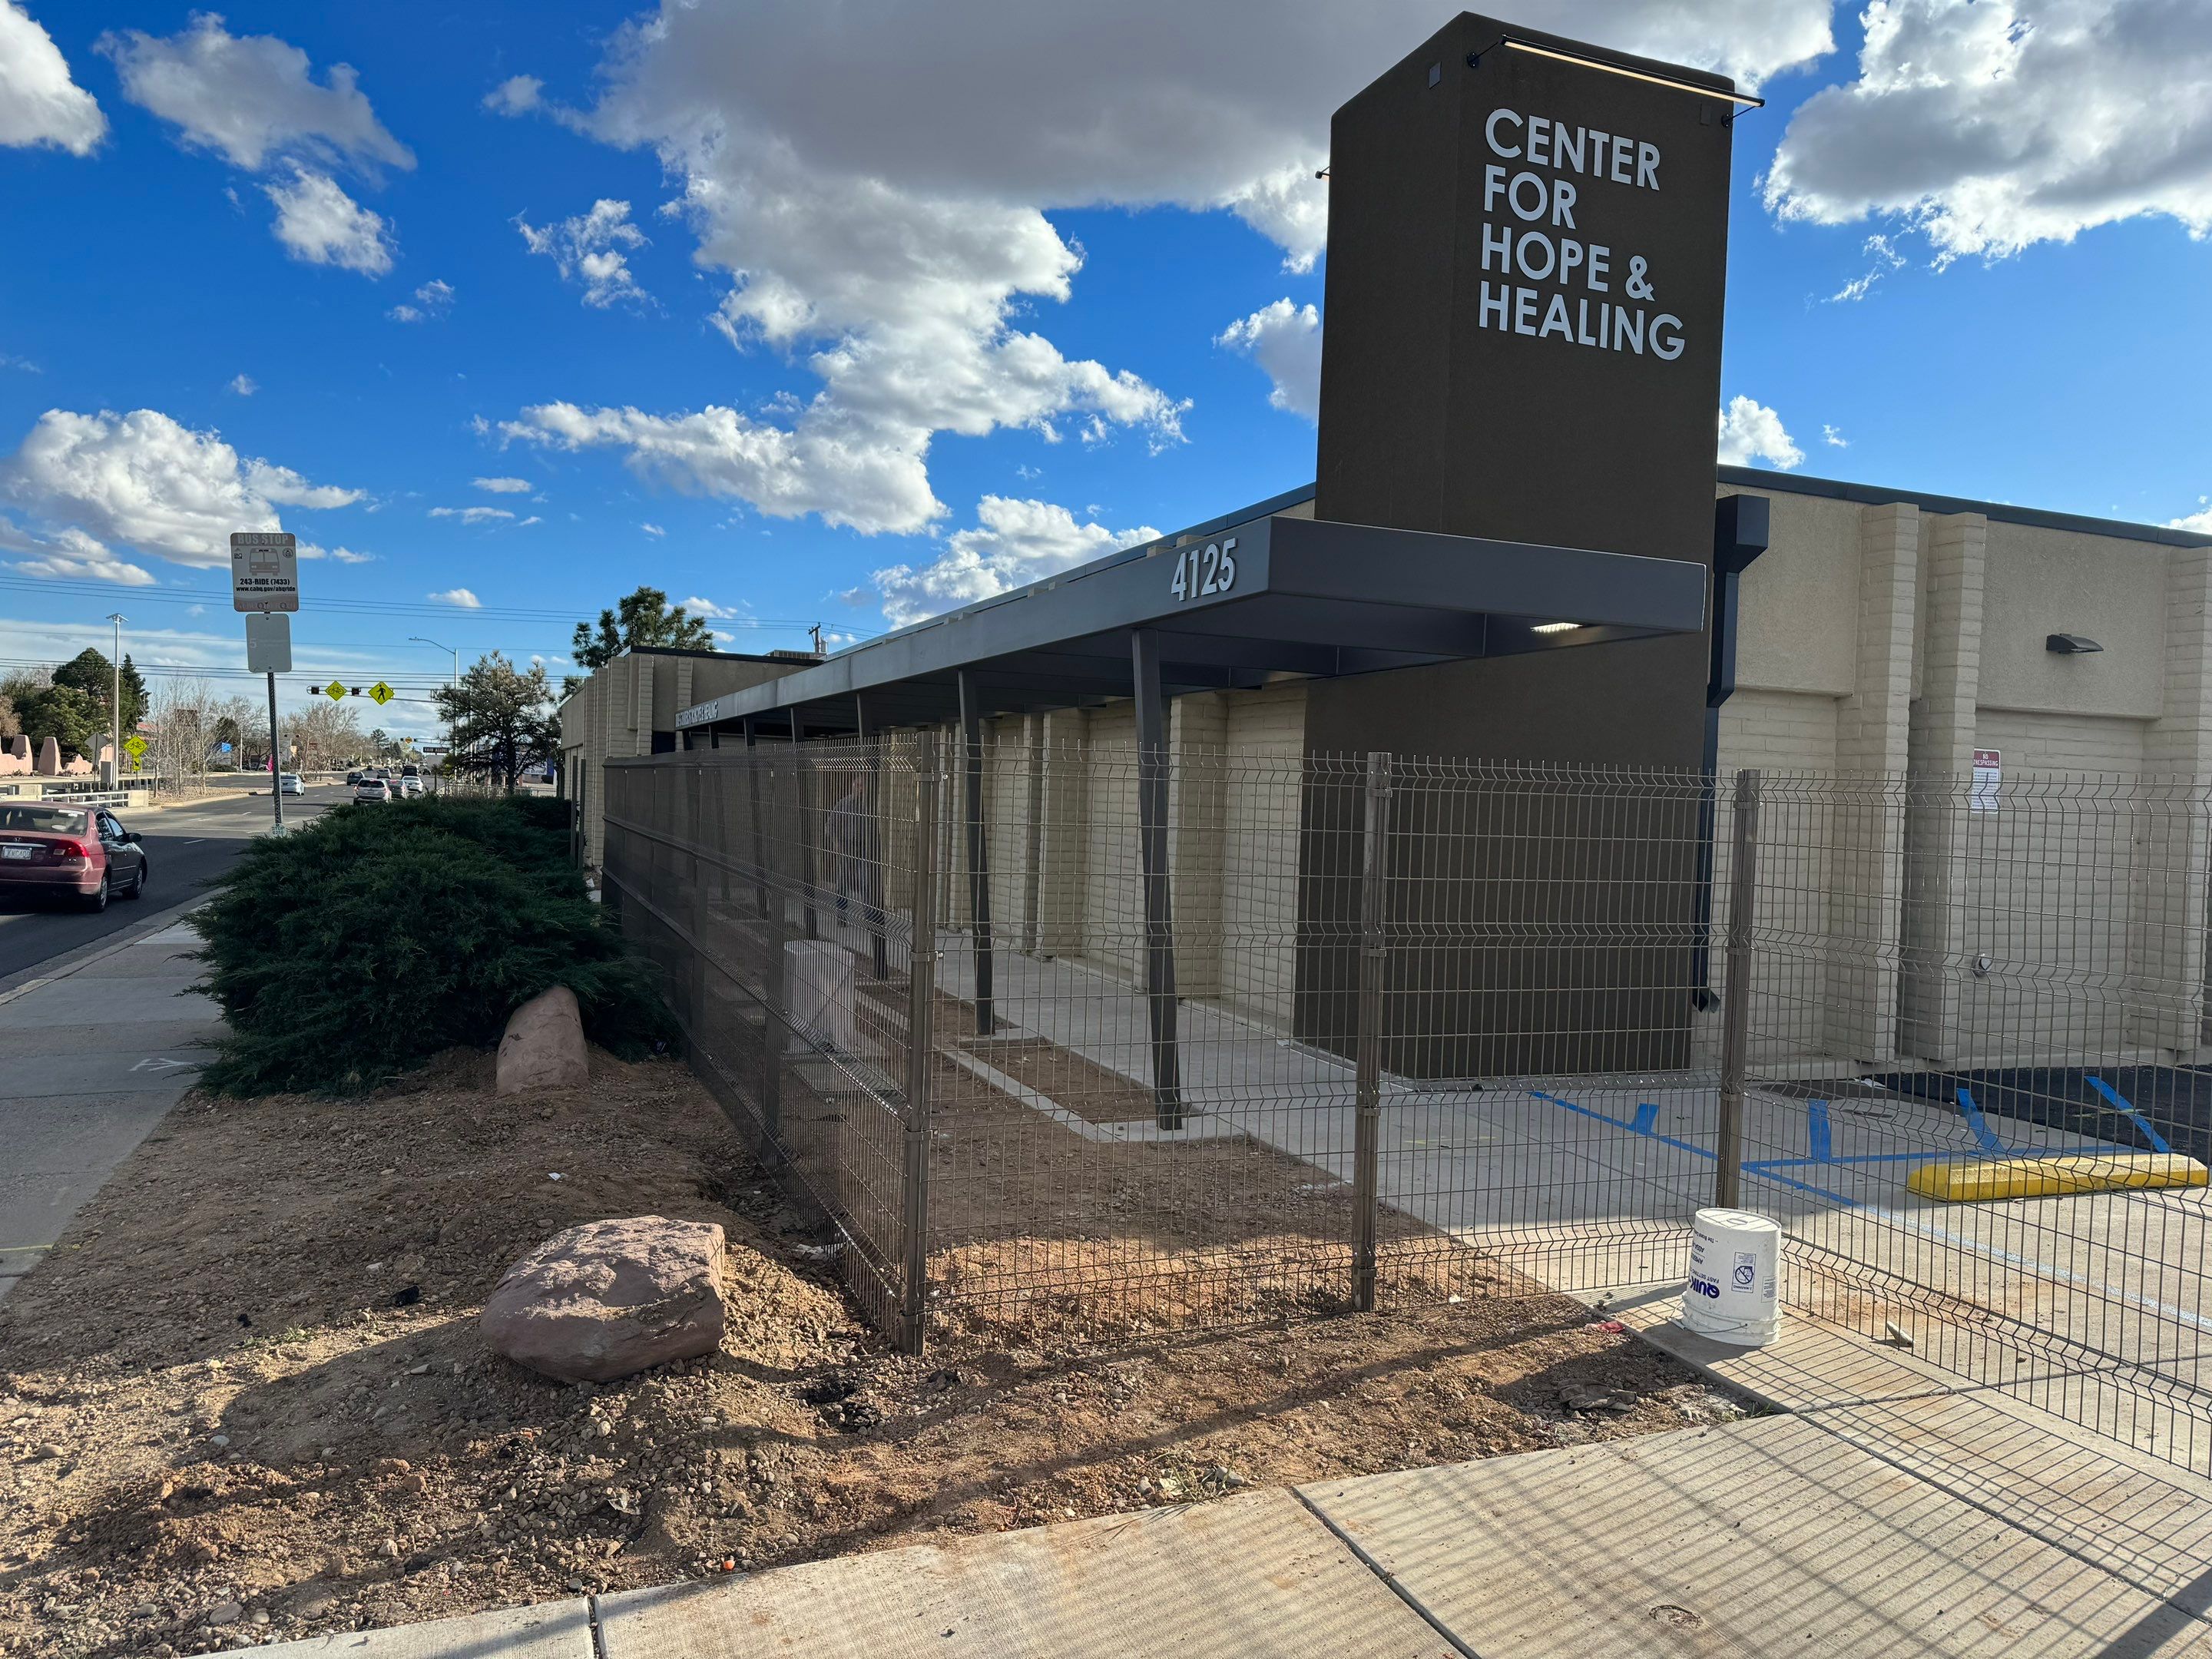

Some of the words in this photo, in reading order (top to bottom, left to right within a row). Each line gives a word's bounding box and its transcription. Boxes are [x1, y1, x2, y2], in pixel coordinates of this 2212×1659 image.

[1485, 108, 1661, 191] CENTER
[1483, 164, 1577, 230] FOR
[1481, 222, 1610, 293] HOPE
[1625, 255, 1655, 302] &
[1479, 280, 1686, 361] HEALING
[237, 534, 259, 545] BUS
[261, 534, 289, 545] STOP
[1171, 537, 1237, 601] 4125
[1689, 1275, 1720, 1299] QUIK
